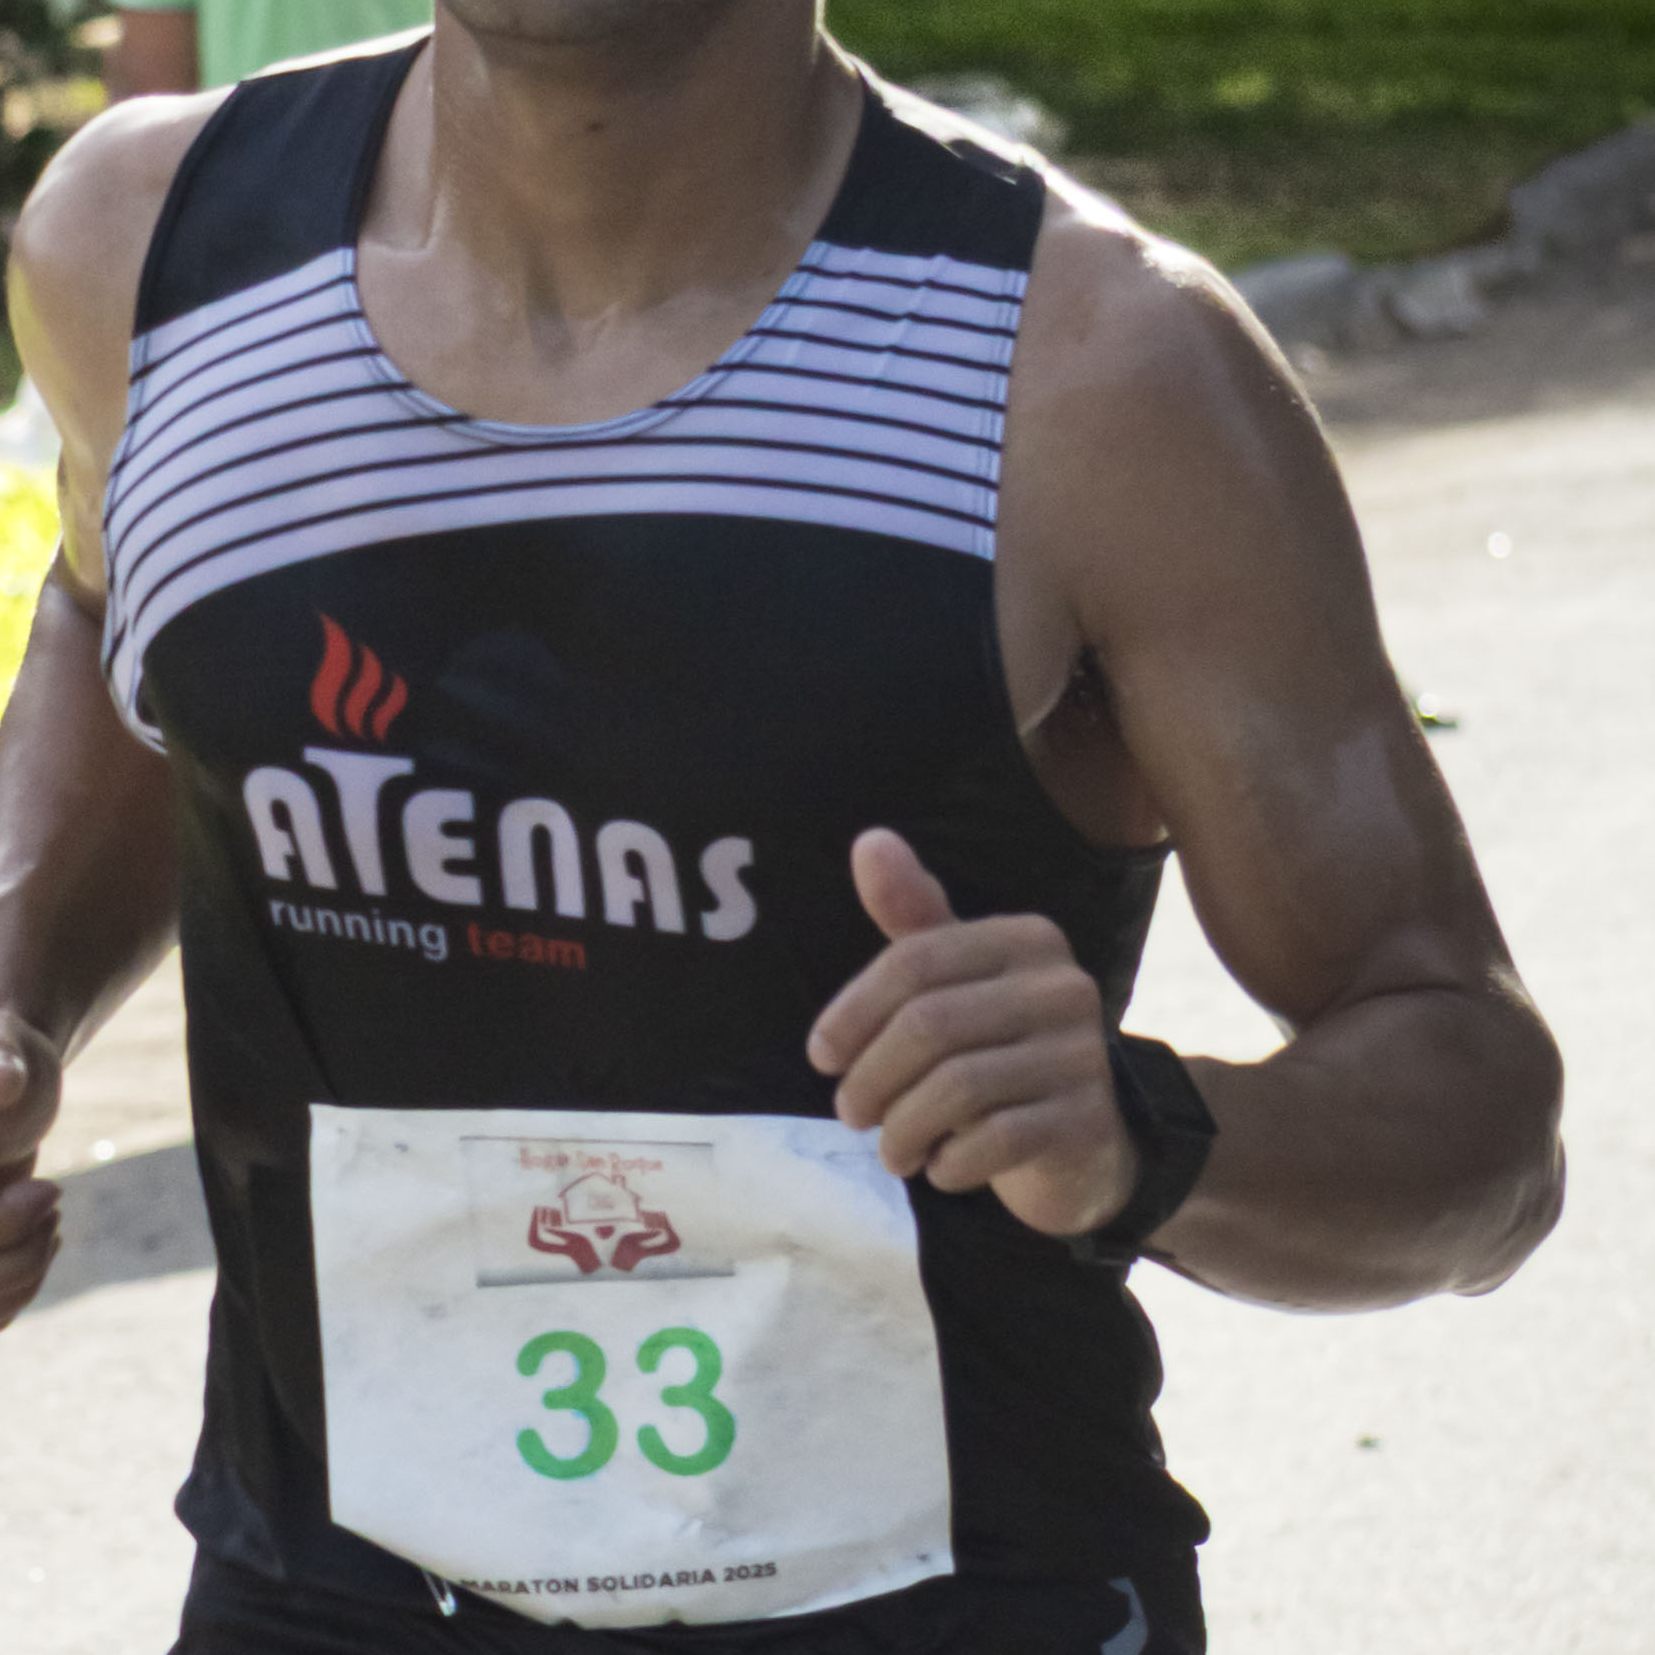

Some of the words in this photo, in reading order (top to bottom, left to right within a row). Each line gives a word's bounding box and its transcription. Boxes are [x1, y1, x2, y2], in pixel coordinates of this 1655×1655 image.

[242, 746, 757, 941] ATENAS
[269, 899, 448, 962] running
[466, 922, 586, 970] team
[515, 1326, 737, 1480] 33
[586, 1569, 716, 1593] SOLIDARIA
[723, 1561, 778, 1582] 2025
